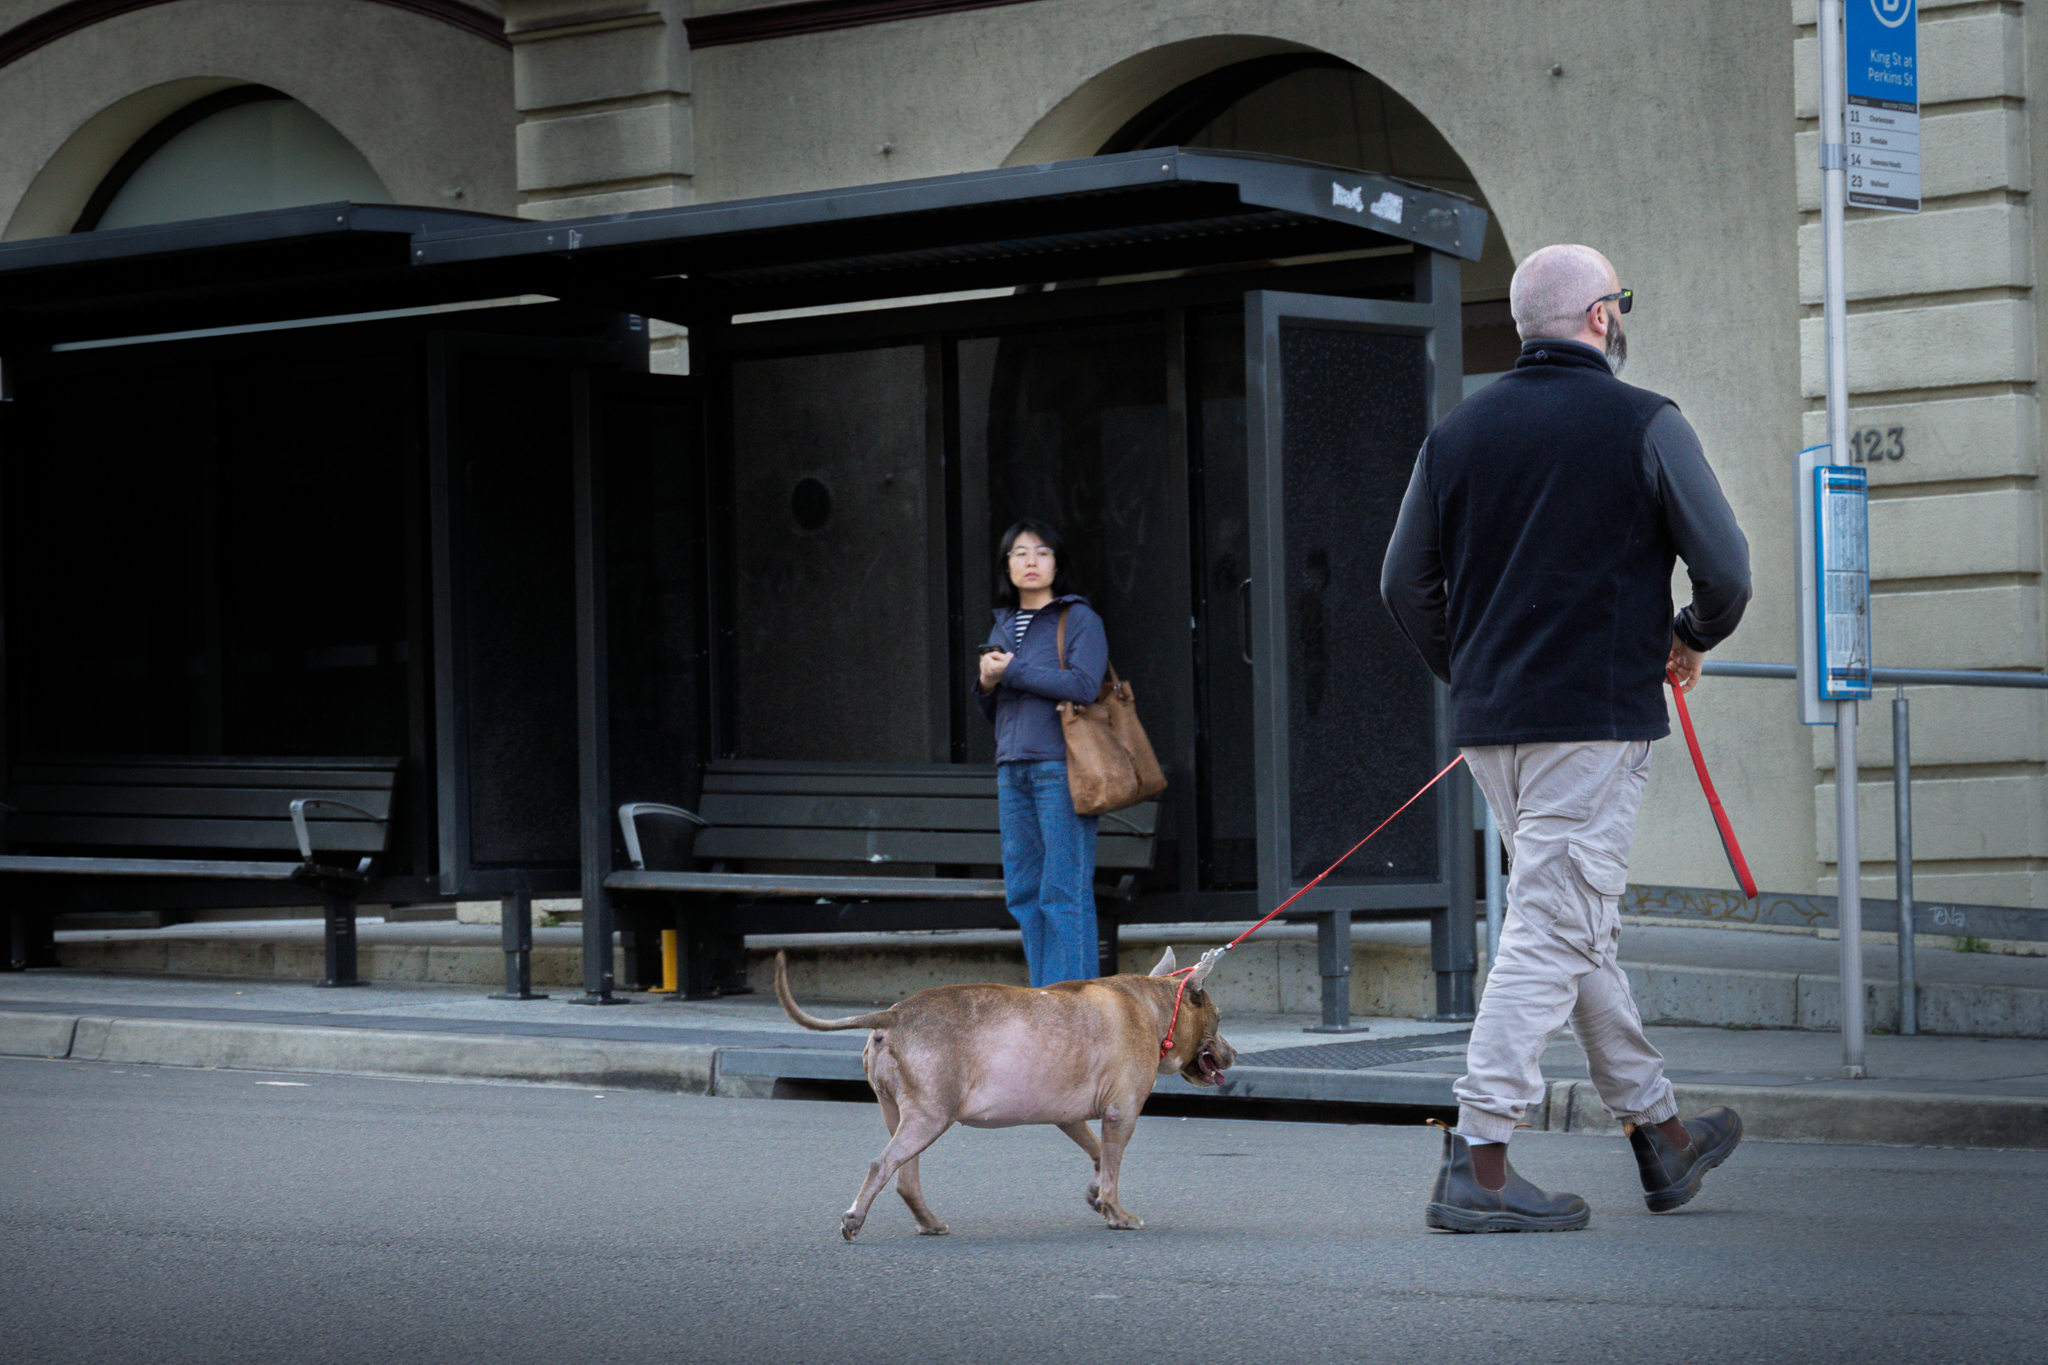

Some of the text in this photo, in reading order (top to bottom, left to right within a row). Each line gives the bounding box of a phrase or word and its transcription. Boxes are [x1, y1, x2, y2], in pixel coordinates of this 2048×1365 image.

[1870, 48, 1913, 68] King St at
[1868, 67, 1914, 86] Perkins St
[1850, 110, 1860, 122] 11
[1850, 131, 1861, 144] 13
[1851, 153, 1861, 166] 14
[1851, 174, 1863, 187] 23
[1851, 426, 1905, 463] 123
